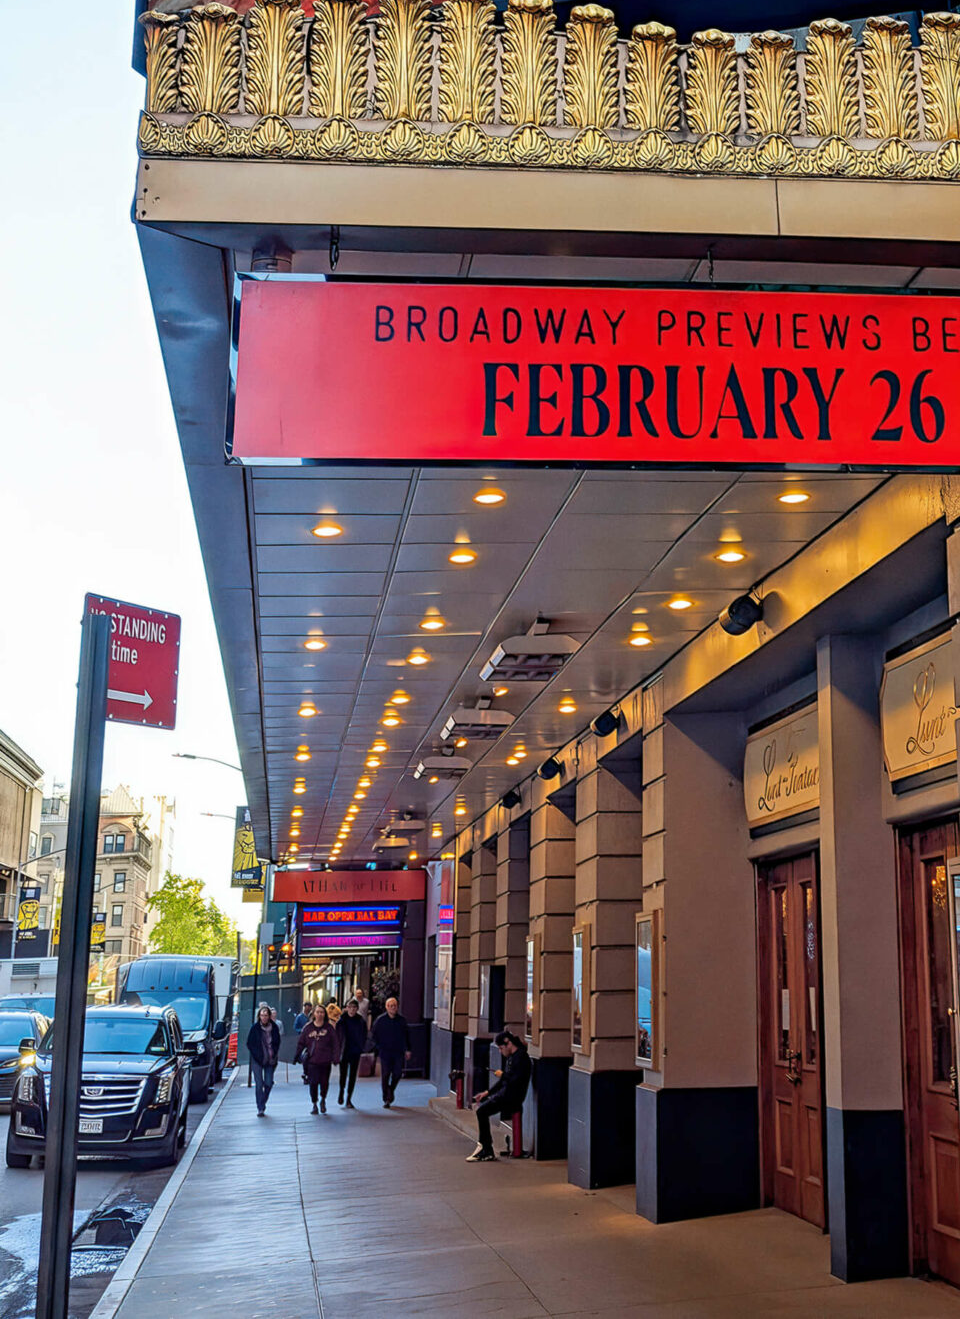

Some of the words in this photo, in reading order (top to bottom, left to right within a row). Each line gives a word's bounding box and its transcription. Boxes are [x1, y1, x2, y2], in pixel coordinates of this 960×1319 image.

[374, 305, 626, 345] BROADWAY
[657, 309, 882, 351] PREVIEWS
[482, 362, 845, 441] FEBRUARY
[869, 368, 946, 444] 26
[110, 613, 166, 644] STANDING
